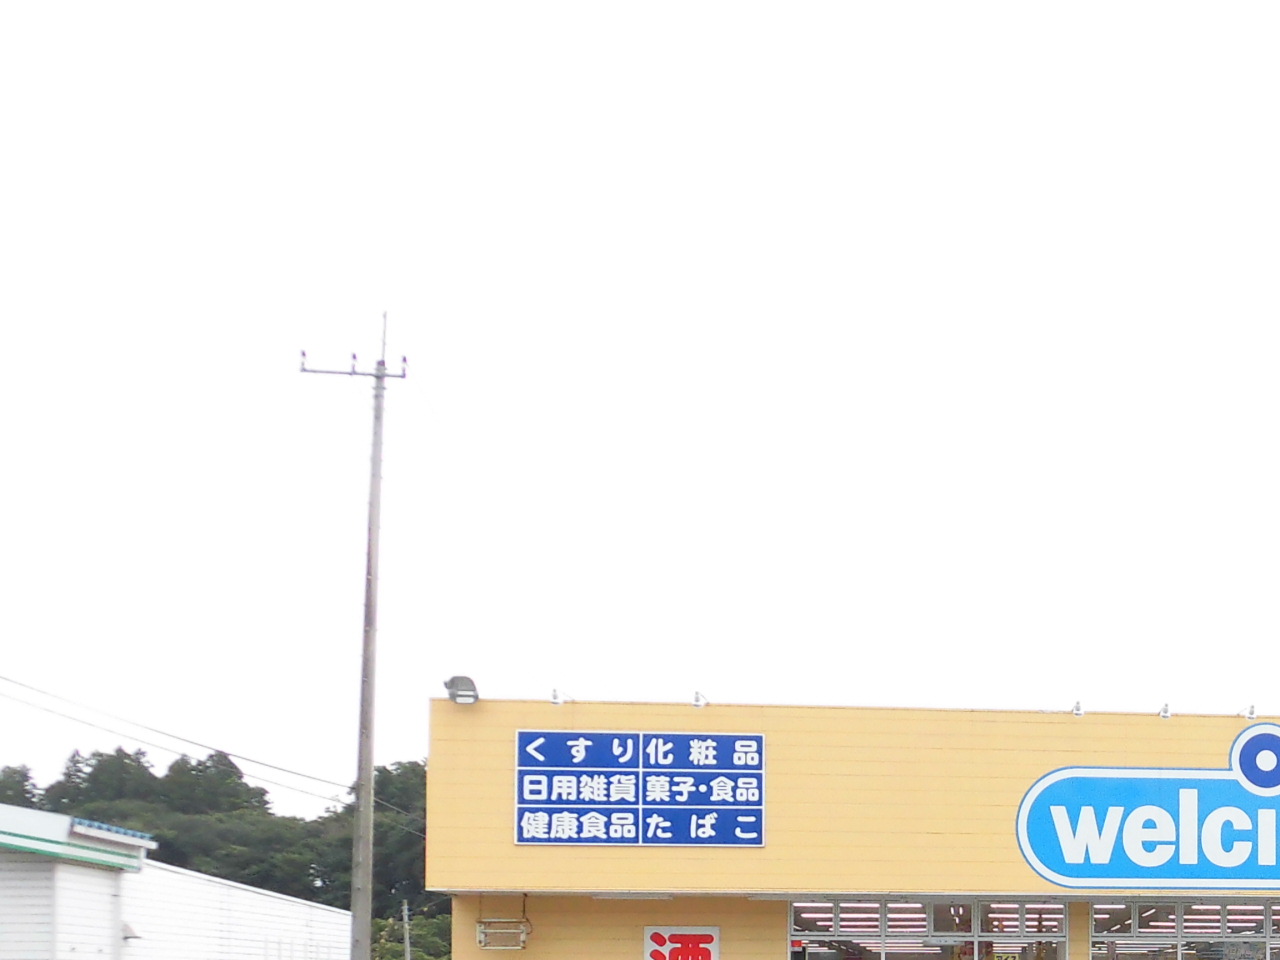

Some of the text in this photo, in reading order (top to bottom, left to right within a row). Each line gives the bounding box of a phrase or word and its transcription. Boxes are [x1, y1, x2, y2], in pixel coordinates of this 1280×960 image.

[525, 737, 634, 763] くすり
[645, 738, 760, 765] 化粧品
[522, 774, 637, 802] 日用雑貨
[520, 811, 636, 839] 健康食品
[645, 812, 759, 839] たばこ
